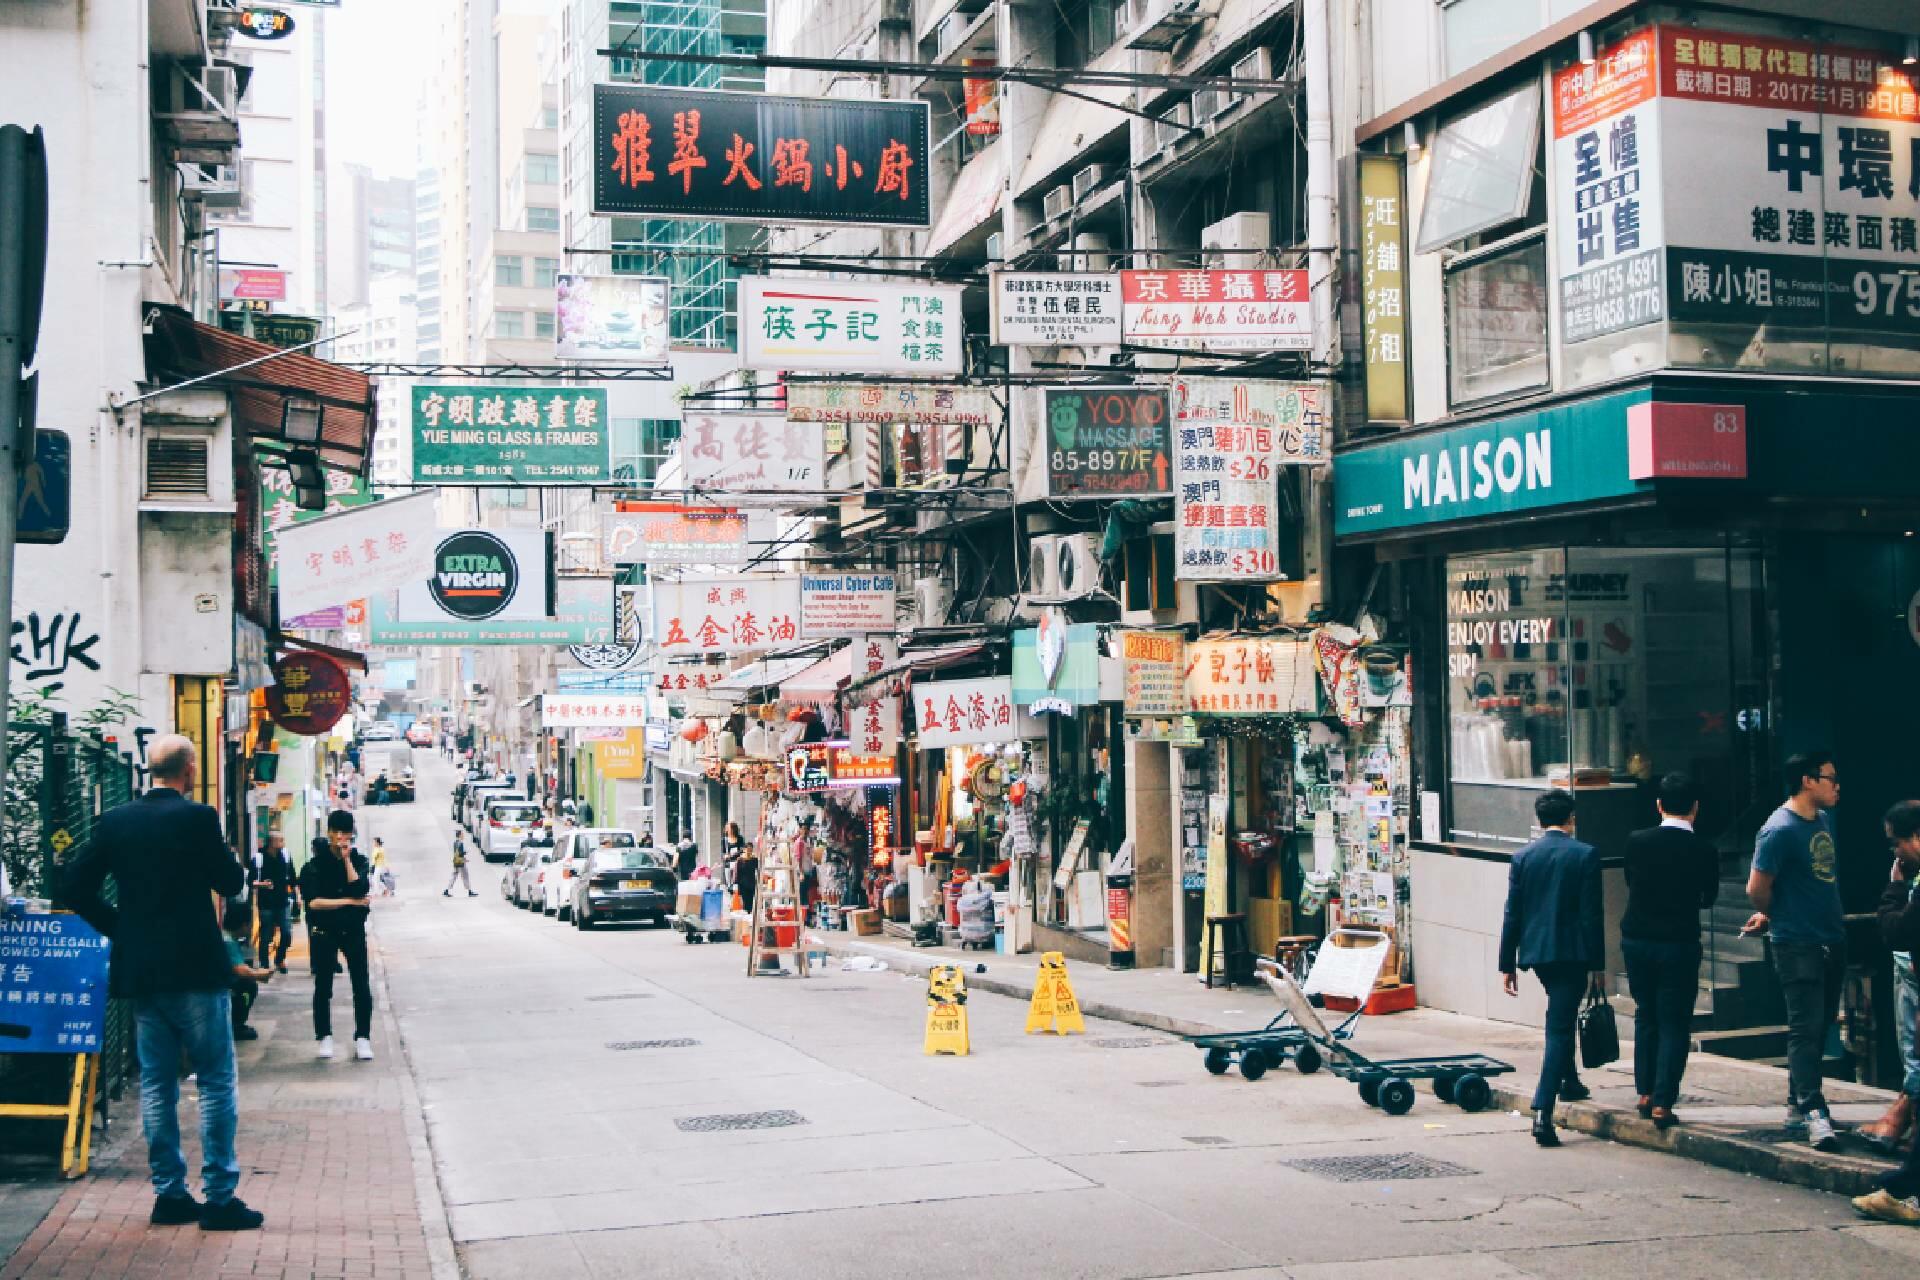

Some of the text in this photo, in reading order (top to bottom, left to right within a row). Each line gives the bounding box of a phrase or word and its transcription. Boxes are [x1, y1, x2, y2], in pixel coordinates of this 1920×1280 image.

[1577, 198, 1640, 268] 出售
[1135, 272, 1296, 300] 京華攝影
[1593, 255, 1658, 301] 9755 4591
[1681, 262, 1773, 307] 陳小姐
[762, 305, 879, 341] 筷子記
[1595, 300, 1628, 335] 9658
[1086, 395, 1164, 424] YOYO
[1713, 412, 1738, 433] 83
[421, 430, 598, 445] YUE MING GLASS & FRAMES
[1079, 427, 1163, 448] MASSAGE
[1230, 456, 1270, 480] $26
[1402, 429, 1553, 509] MAISON
[445, 554, 500, 572] EXTRA
[1232, 550, 1275, 574] $30
[439, 572, 506, 588] VIRGIN
[1448, 589, 1509, 615] MAISON
[660, 611, 797, 648] 五金漆油
[1448, 617, 1552, 645] ENJOY EVERY
[1448, 653, 1477, 677] SIP!
[921, 691, 1010, 731] 五金漆油
[43, 949, 81, 958] AWAY
